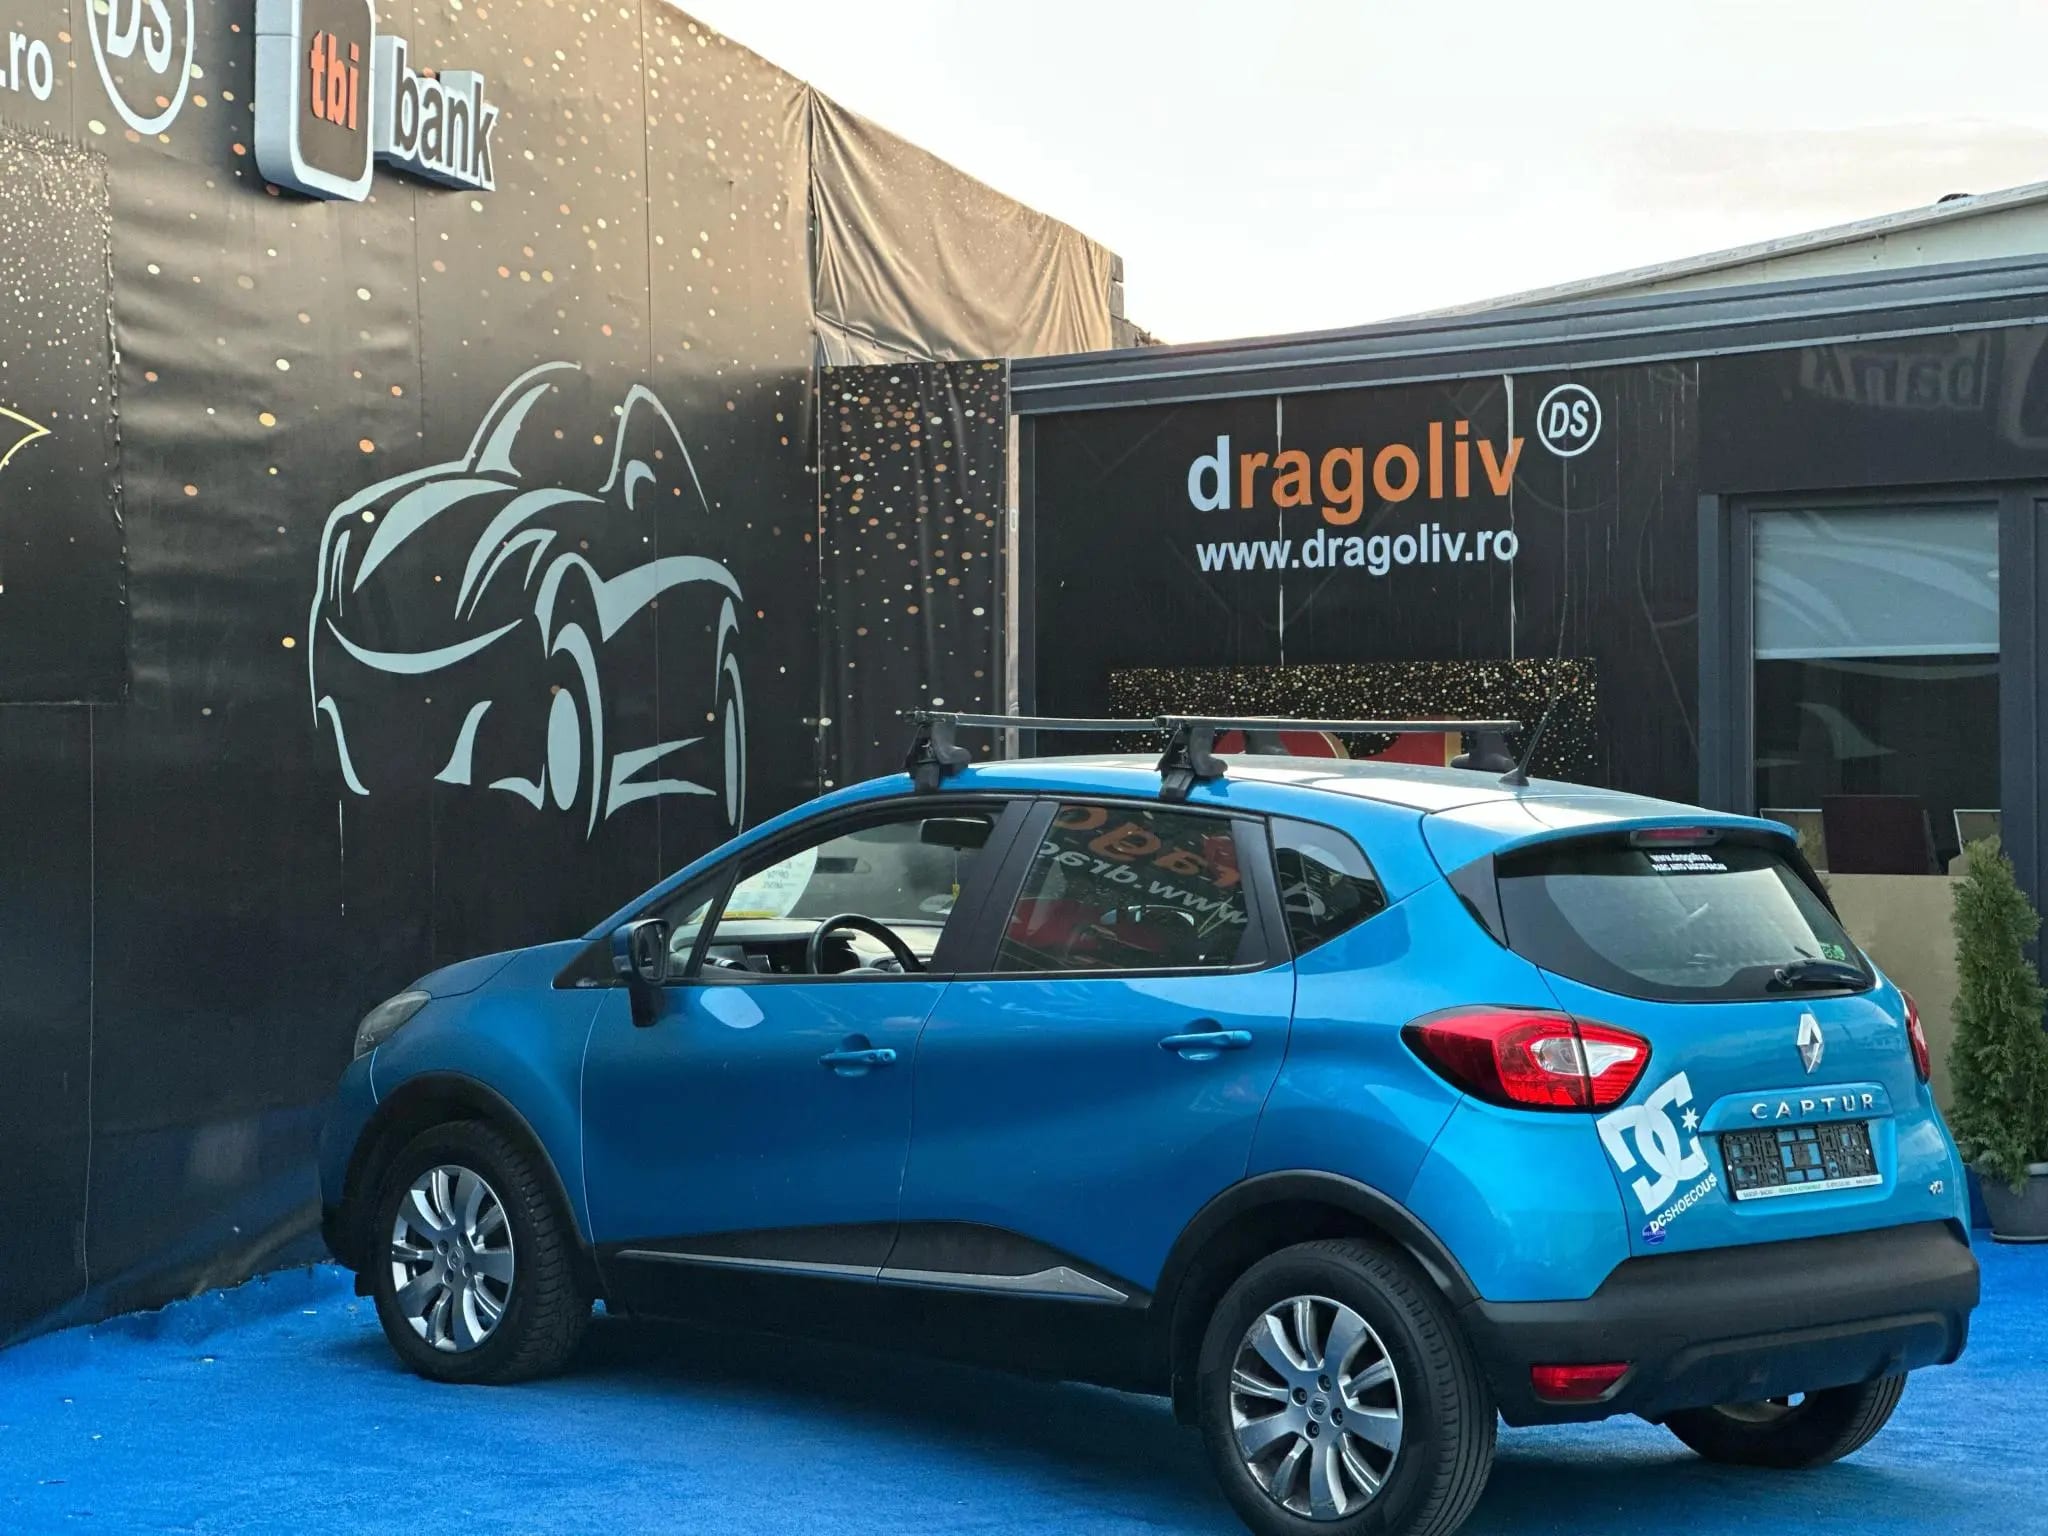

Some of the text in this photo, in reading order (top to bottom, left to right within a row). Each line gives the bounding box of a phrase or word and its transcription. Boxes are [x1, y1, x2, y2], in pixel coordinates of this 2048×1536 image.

[309, 29, 498, 190] tbi bank
[1548, 400, 1590, 439] DS
[1187, 420, 1525, 525] dragoliv
[1196, 522, 1519, 577] www.dragoliv.ro
[1751, 1093, 1873, 1119] CAPTUR
[1649, 1172, 1718, 1233] DCSHOECOUS
